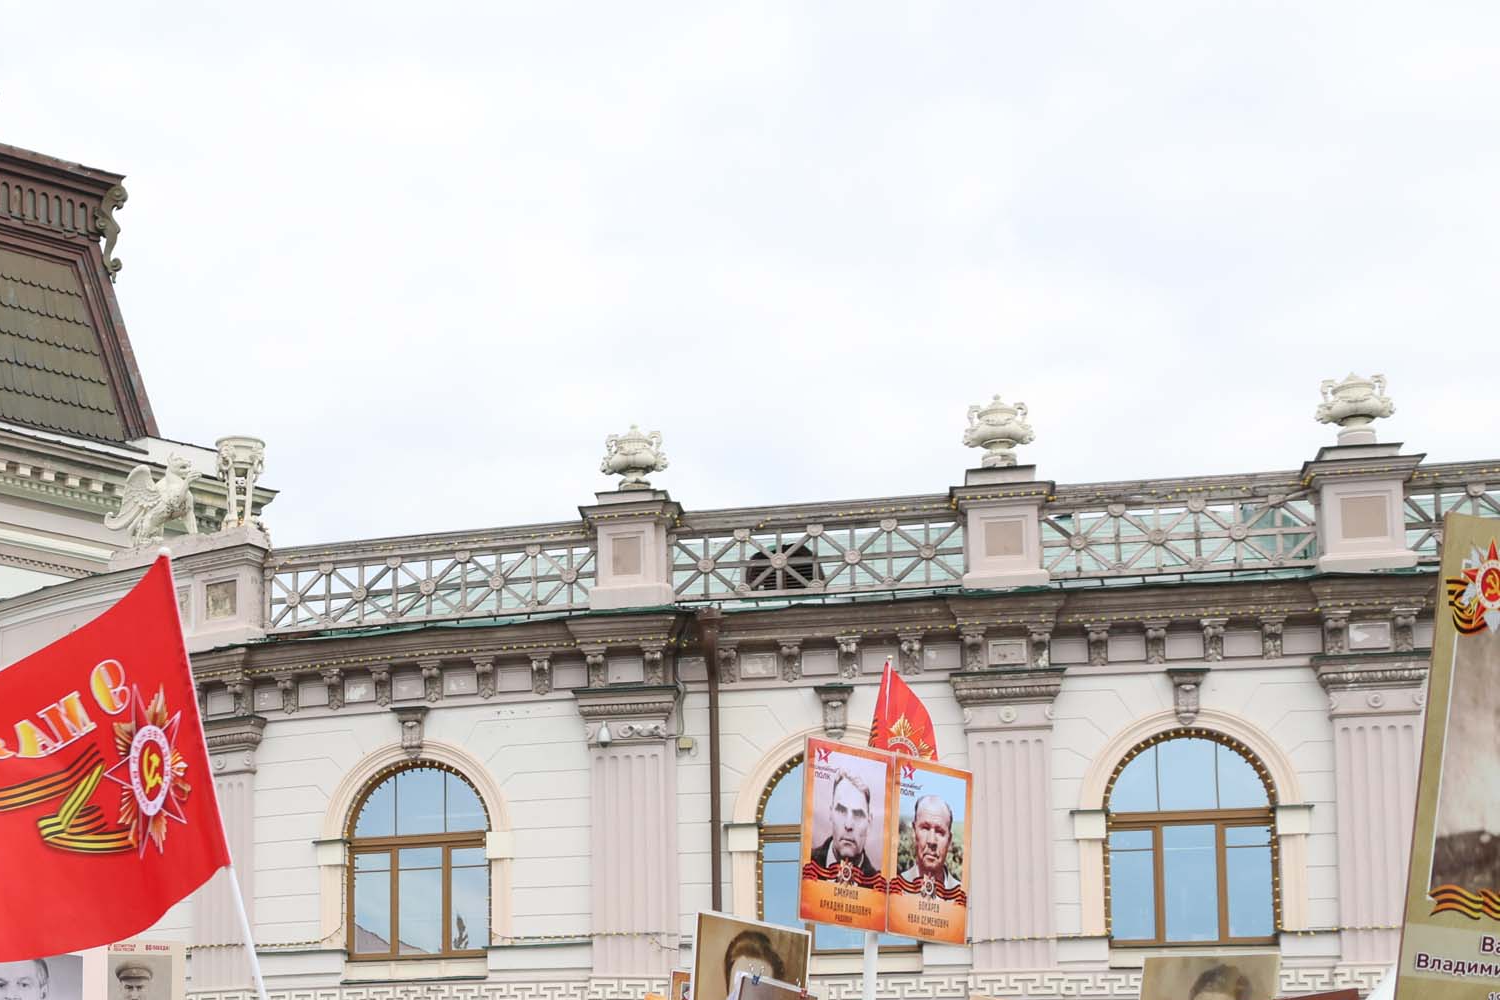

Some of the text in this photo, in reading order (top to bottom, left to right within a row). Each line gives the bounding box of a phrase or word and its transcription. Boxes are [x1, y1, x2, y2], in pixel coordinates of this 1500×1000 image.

[833, 887, 859, 900] СМИРНОВ
[845, 902, 872, 918] ПАВЛОВИЧ
[918, 901, 940, 914] БОКАРЕВ
[907, 912, 920, 925] ИВАН
